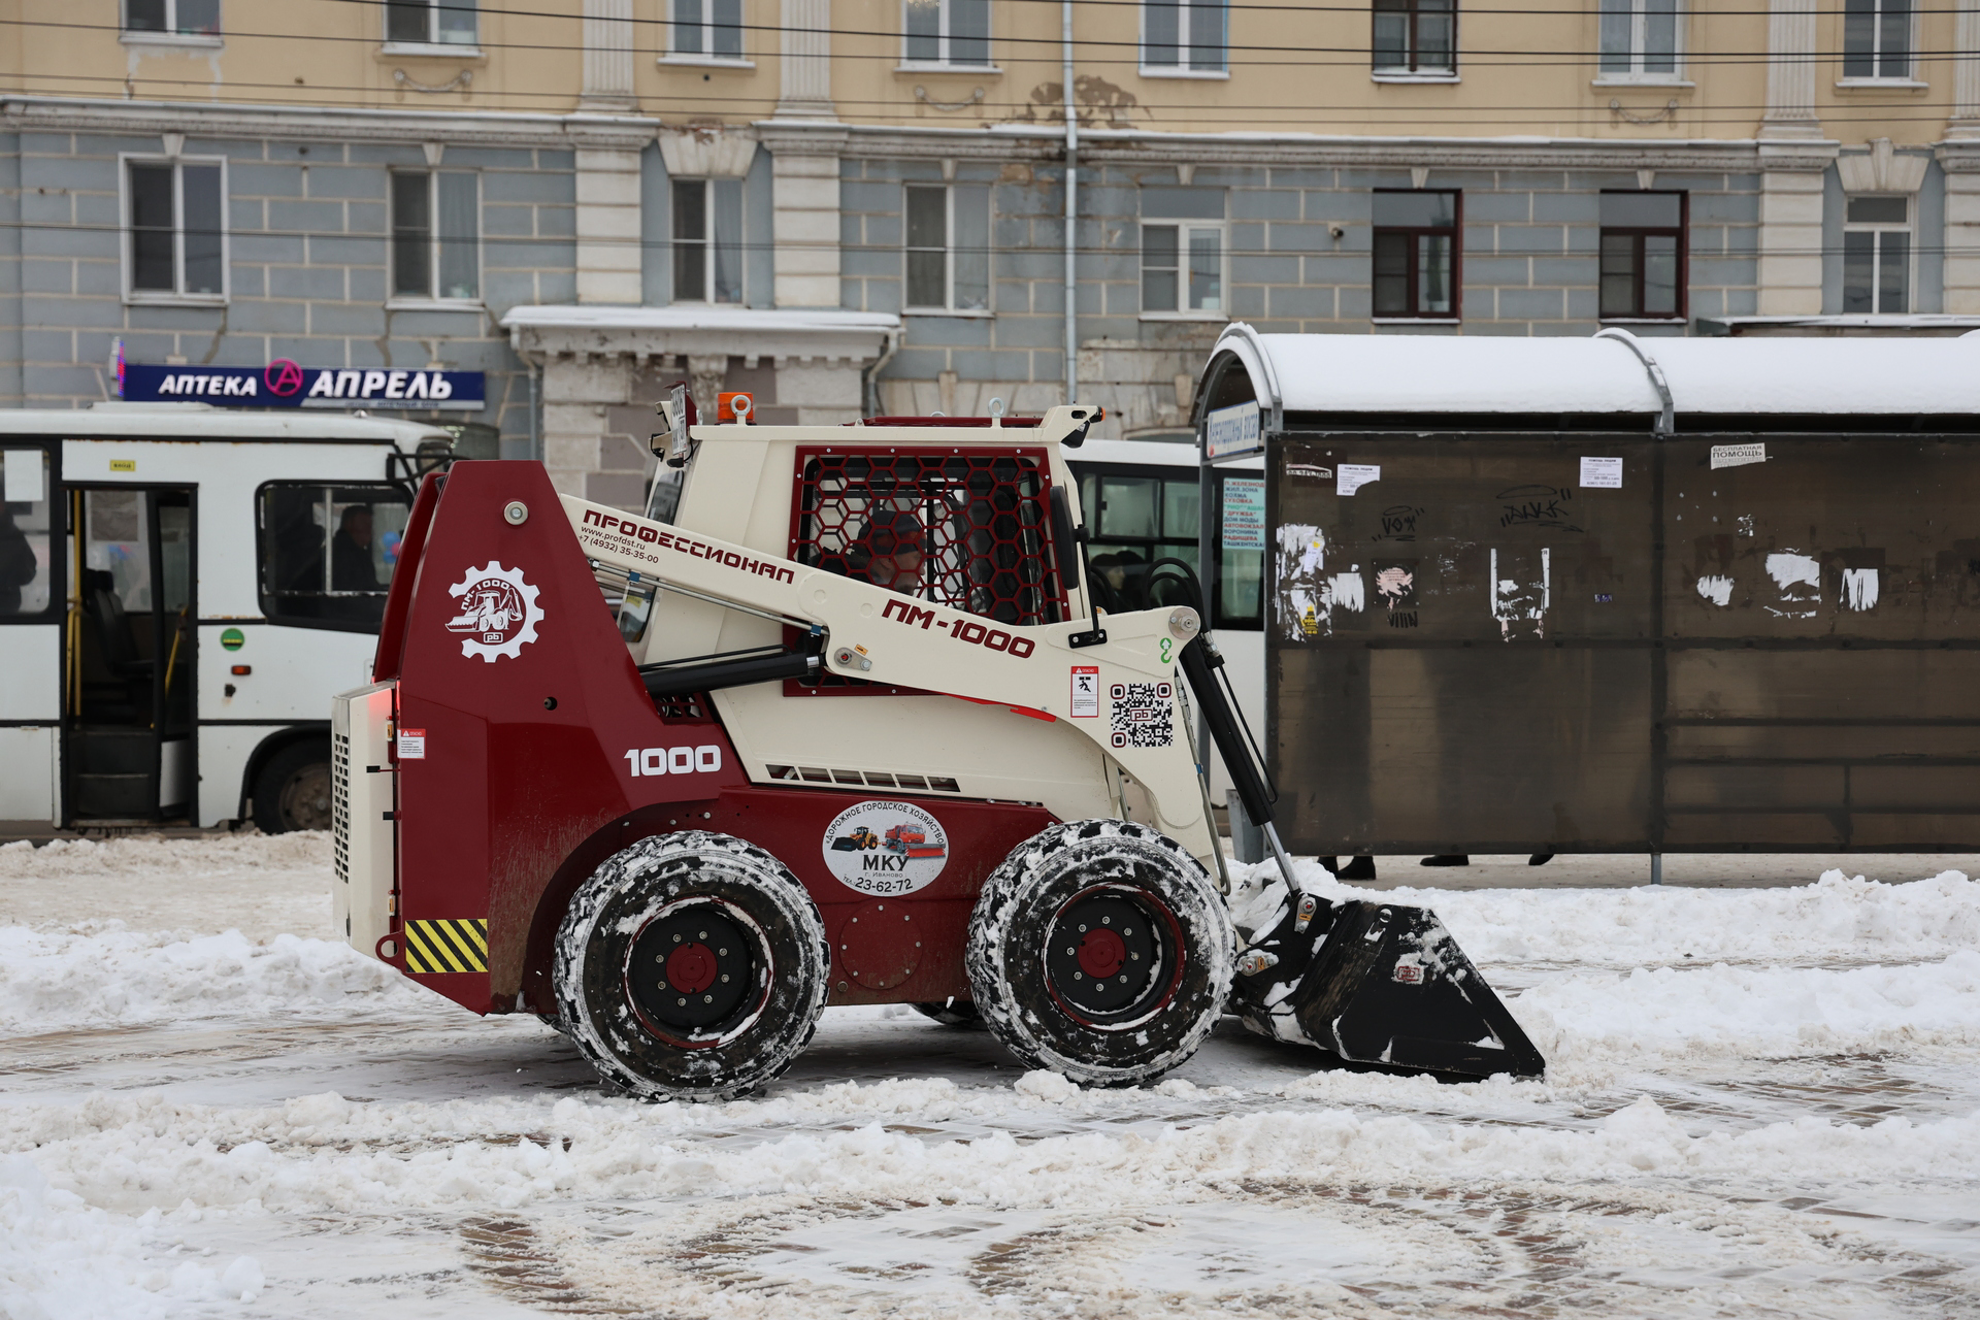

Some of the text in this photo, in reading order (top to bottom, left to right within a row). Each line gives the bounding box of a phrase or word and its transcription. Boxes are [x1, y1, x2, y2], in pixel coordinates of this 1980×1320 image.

[158, 374, 257, 397] АПТЕКА
[308, 370, 453, 399] АПРЕЛЬ
[579, 534, 659, 563] +7 (4932) 35-35-00
[581, 526, 646, 550] www.profdst.ru
[461, 579, 510, 611] ПМ-1000
[881, 598, 1036, 659] ПМ-1000
[623, 744, 722, 778] 1000
[862, 801, 908, 814] ГОРОДСКОЕ
[863, 855, 910, 871] МКУ
[855, 876, 913, 893] 23-62-72
